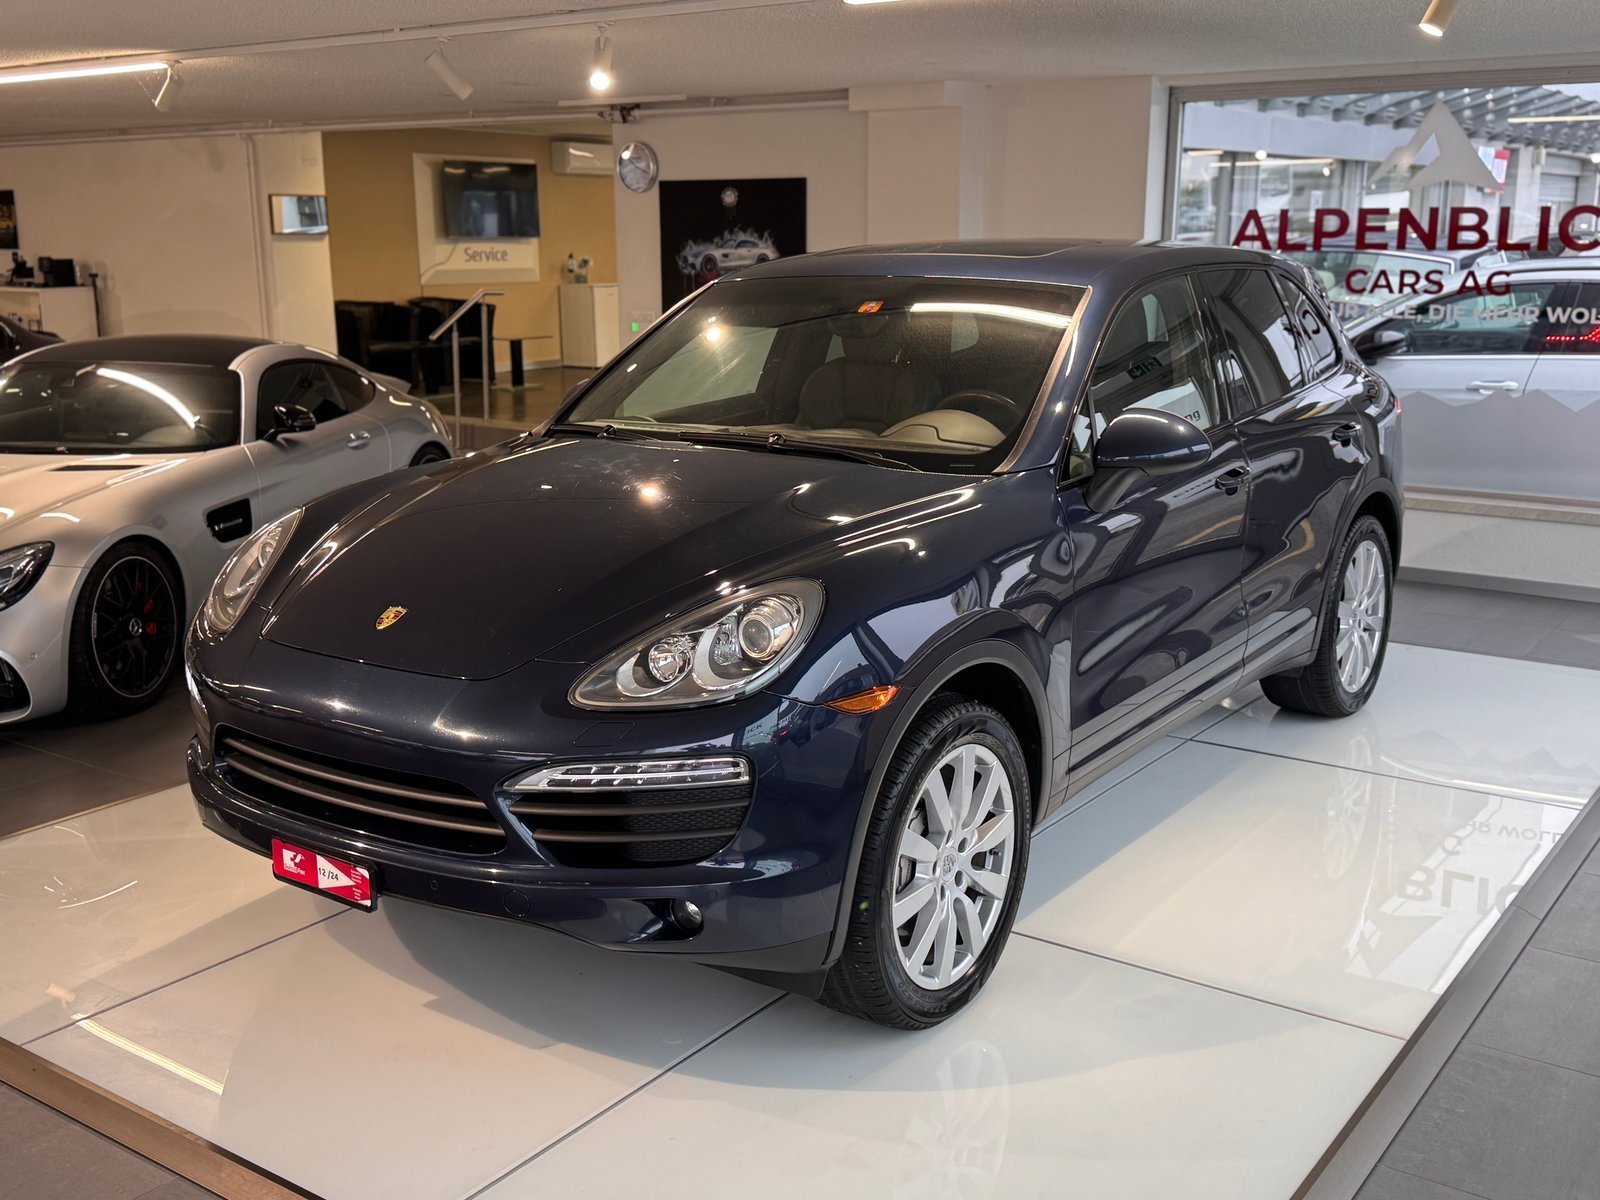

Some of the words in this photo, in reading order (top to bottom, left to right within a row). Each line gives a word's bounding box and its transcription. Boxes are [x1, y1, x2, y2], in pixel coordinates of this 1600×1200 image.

[463, 246, 509, 262] Service
[1345, 269, 1444, 295] CARS
[1456, 269, 1512, 296] AG
[1428, 303, 1466, 321] DIE
[1472, 306, 1540, 323] MEHR
